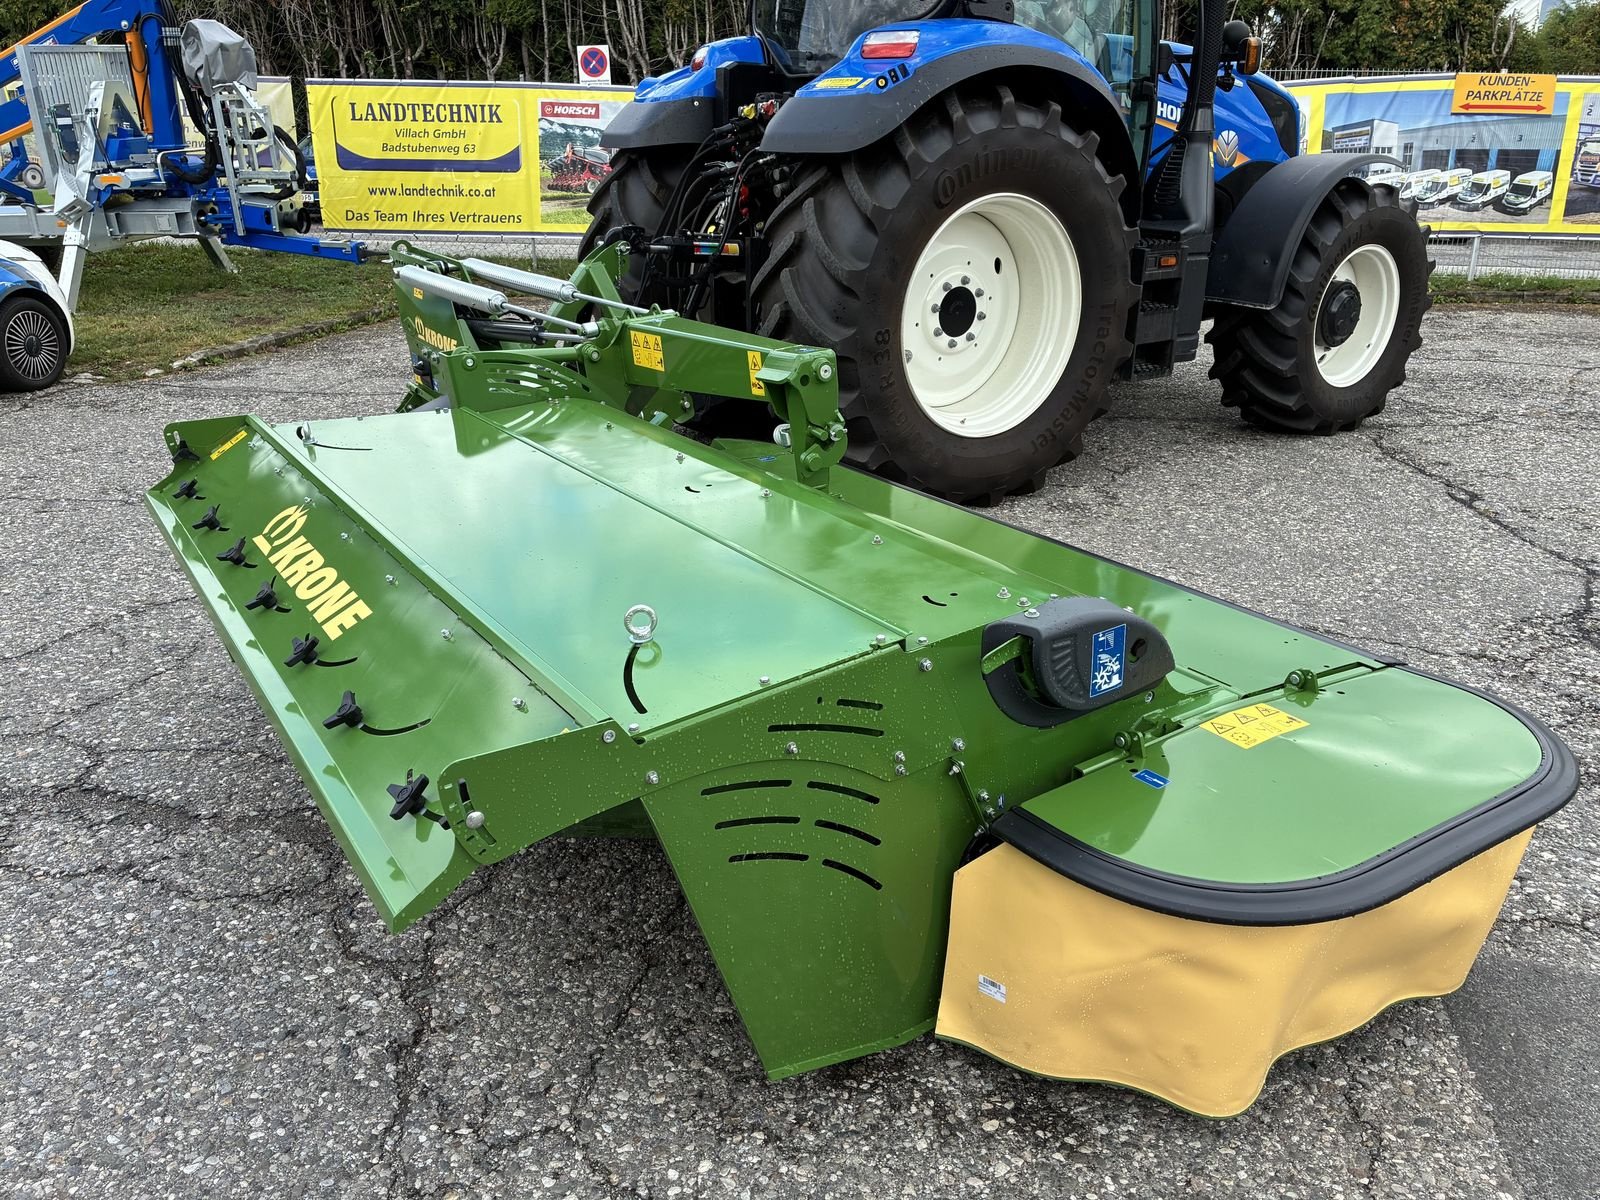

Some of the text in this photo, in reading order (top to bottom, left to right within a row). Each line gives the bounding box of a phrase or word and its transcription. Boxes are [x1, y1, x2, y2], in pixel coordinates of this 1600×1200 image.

[1478, 75, 1536, 87] KUNDEN-
[1465, 87, 1544, 102] PARKPLÄTZE
[349, 102, 503, 123] LANDTECHNIK
[553, 105, 597, 115] HORSCH
[395, 128, 466, 139] Villach GmbH
[381, 142, 476, 155] Badstubenweg 63
[368, 183, 496, 198] www.landtechnik.co.at
[345, 209, 522, 224] Das Team Ihres Vertrauens
[425, 327, 458, 352] KRONE
[872, 327, 891, 366] 38
[1030, 297, 1117, 456] TractorMaster
[268, 535, 373, 641] KRONE
